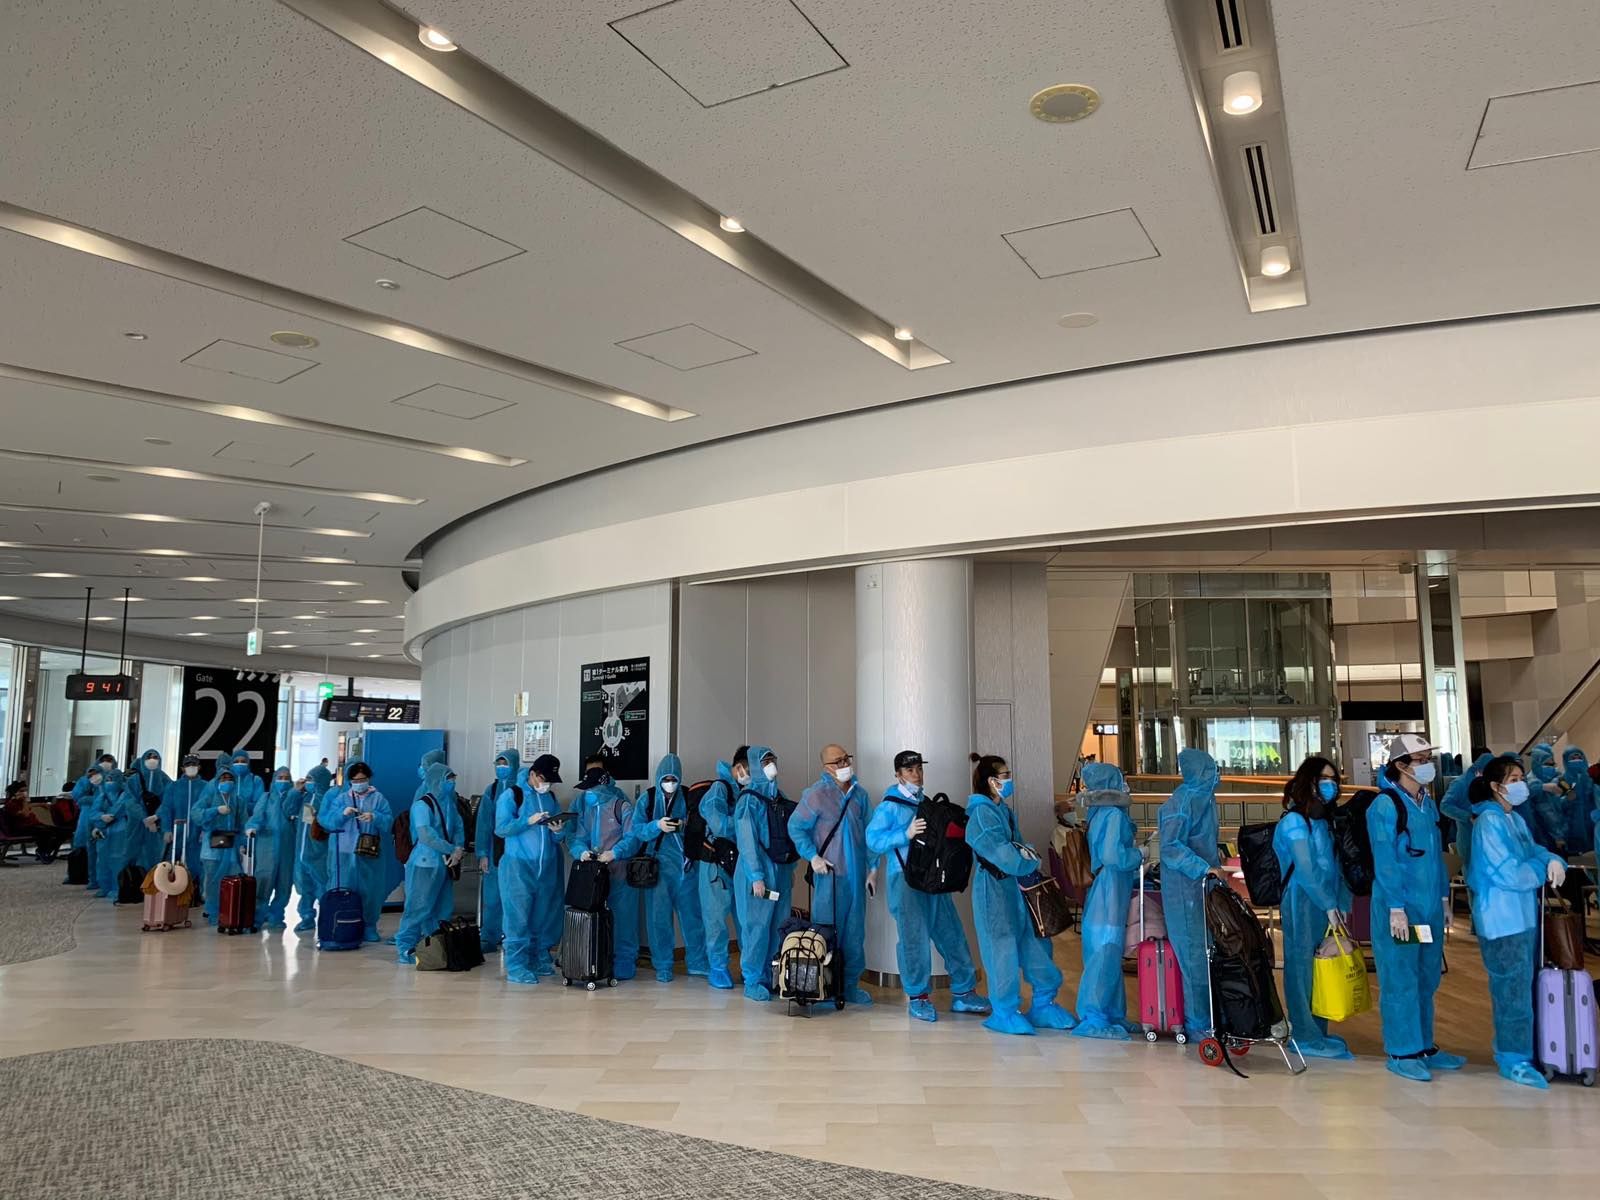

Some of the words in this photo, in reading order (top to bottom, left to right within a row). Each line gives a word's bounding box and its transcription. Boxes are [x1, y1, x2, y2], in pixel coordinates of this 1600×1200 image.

[196, 673, 213, 683] Gate
[387, 707, 403, 720] 22
[190, 687, 266, 760] 22
